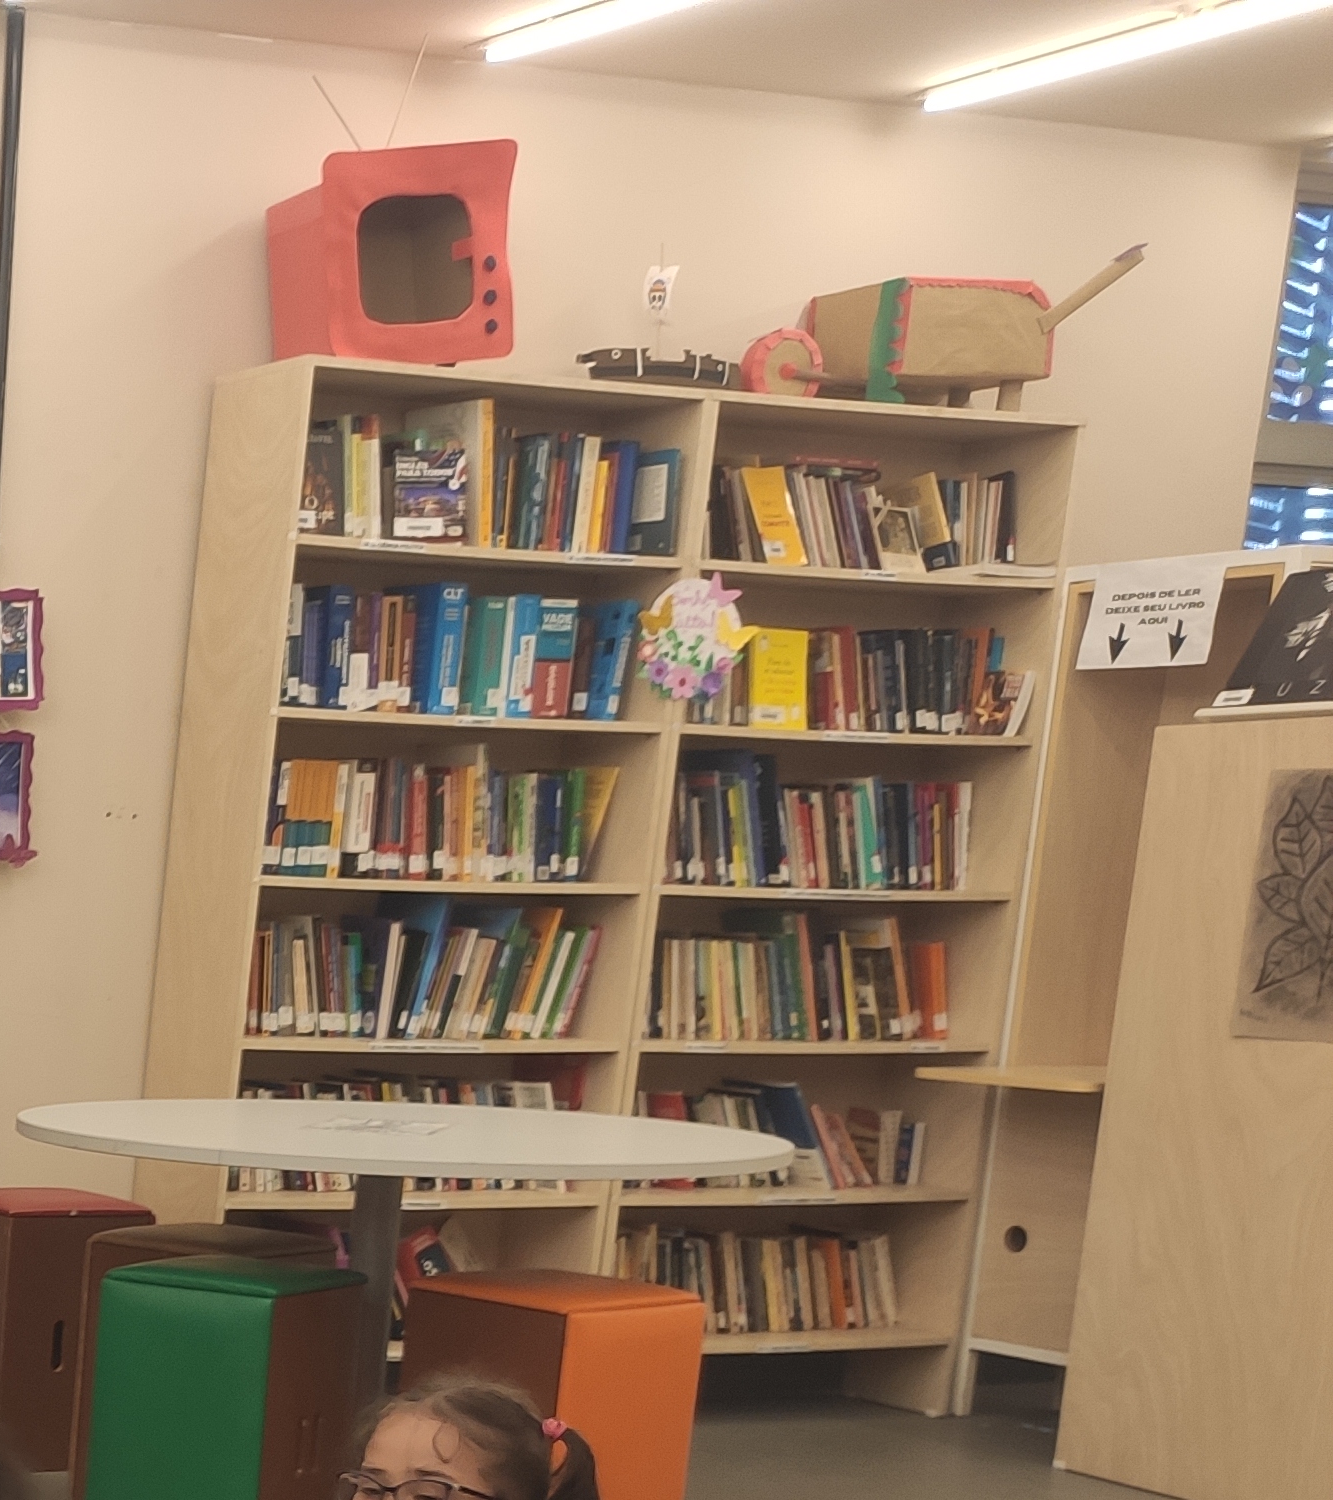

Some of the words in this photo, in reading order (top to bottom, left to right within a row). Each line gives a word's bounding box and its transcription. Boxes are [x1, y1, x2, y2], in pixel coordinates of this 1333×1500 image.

[443, 587, 465, 600] CLT
[1111, 591, 1157, 602] DEPOIS
[1158, 590, 1176, 599] DE
[1177, 588, 1201, 598] LER
[1105, 605, 1141, 615] DEIXE
[1143, 603, 1167, 612] SEU
[1168, 601, 1206, 611] LIVRO
[1137, 616, 1169, 626] AQUI
